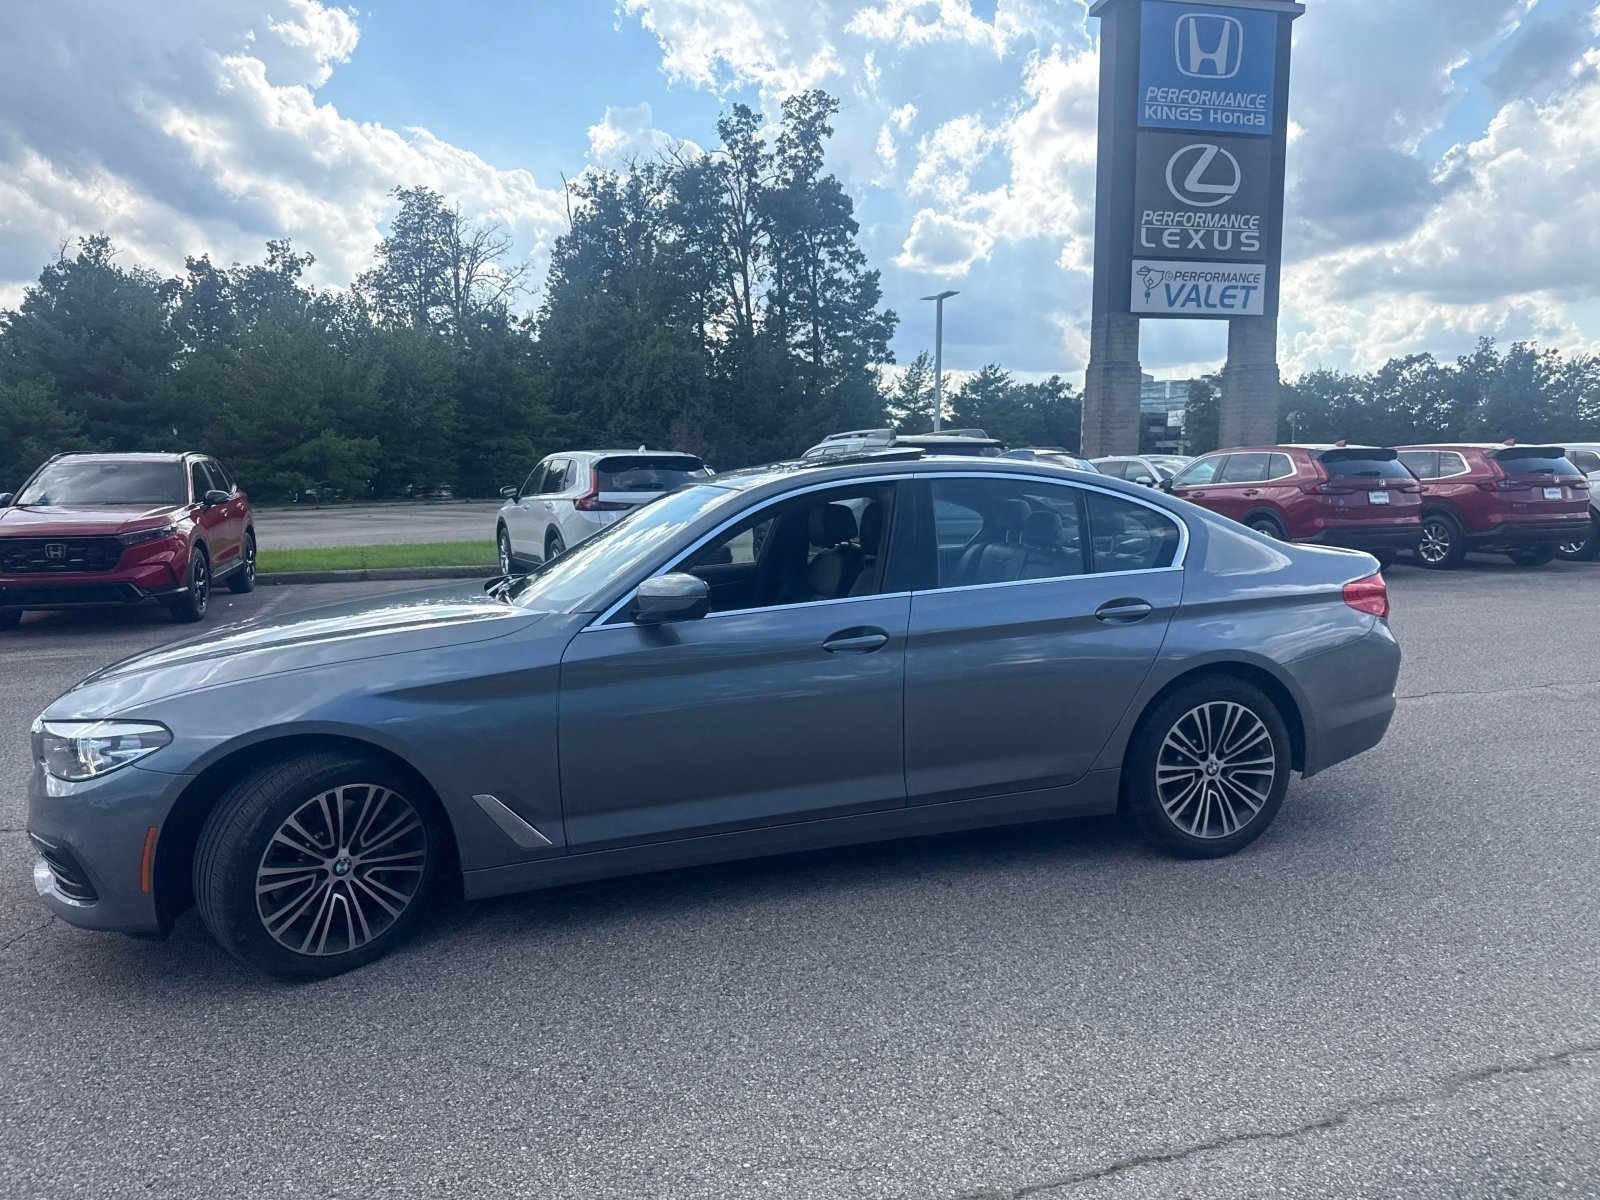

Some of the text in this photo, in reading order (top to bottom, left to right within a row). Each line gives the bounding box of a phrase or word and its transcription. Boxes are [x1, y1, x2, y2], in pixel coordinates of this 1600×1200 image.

[1145, 86, 1266, 109] PERFORMANCE
[1145, 105, 1266, 126] KINGS Honda
[1141, 210, 1260, 229] PERFORMANCE
[1140, 227, 1260, 252] LEXUS
[1173, 271, 1261, 284] PERFORMANCE
[1164, 283, 1258, 309] VALET
